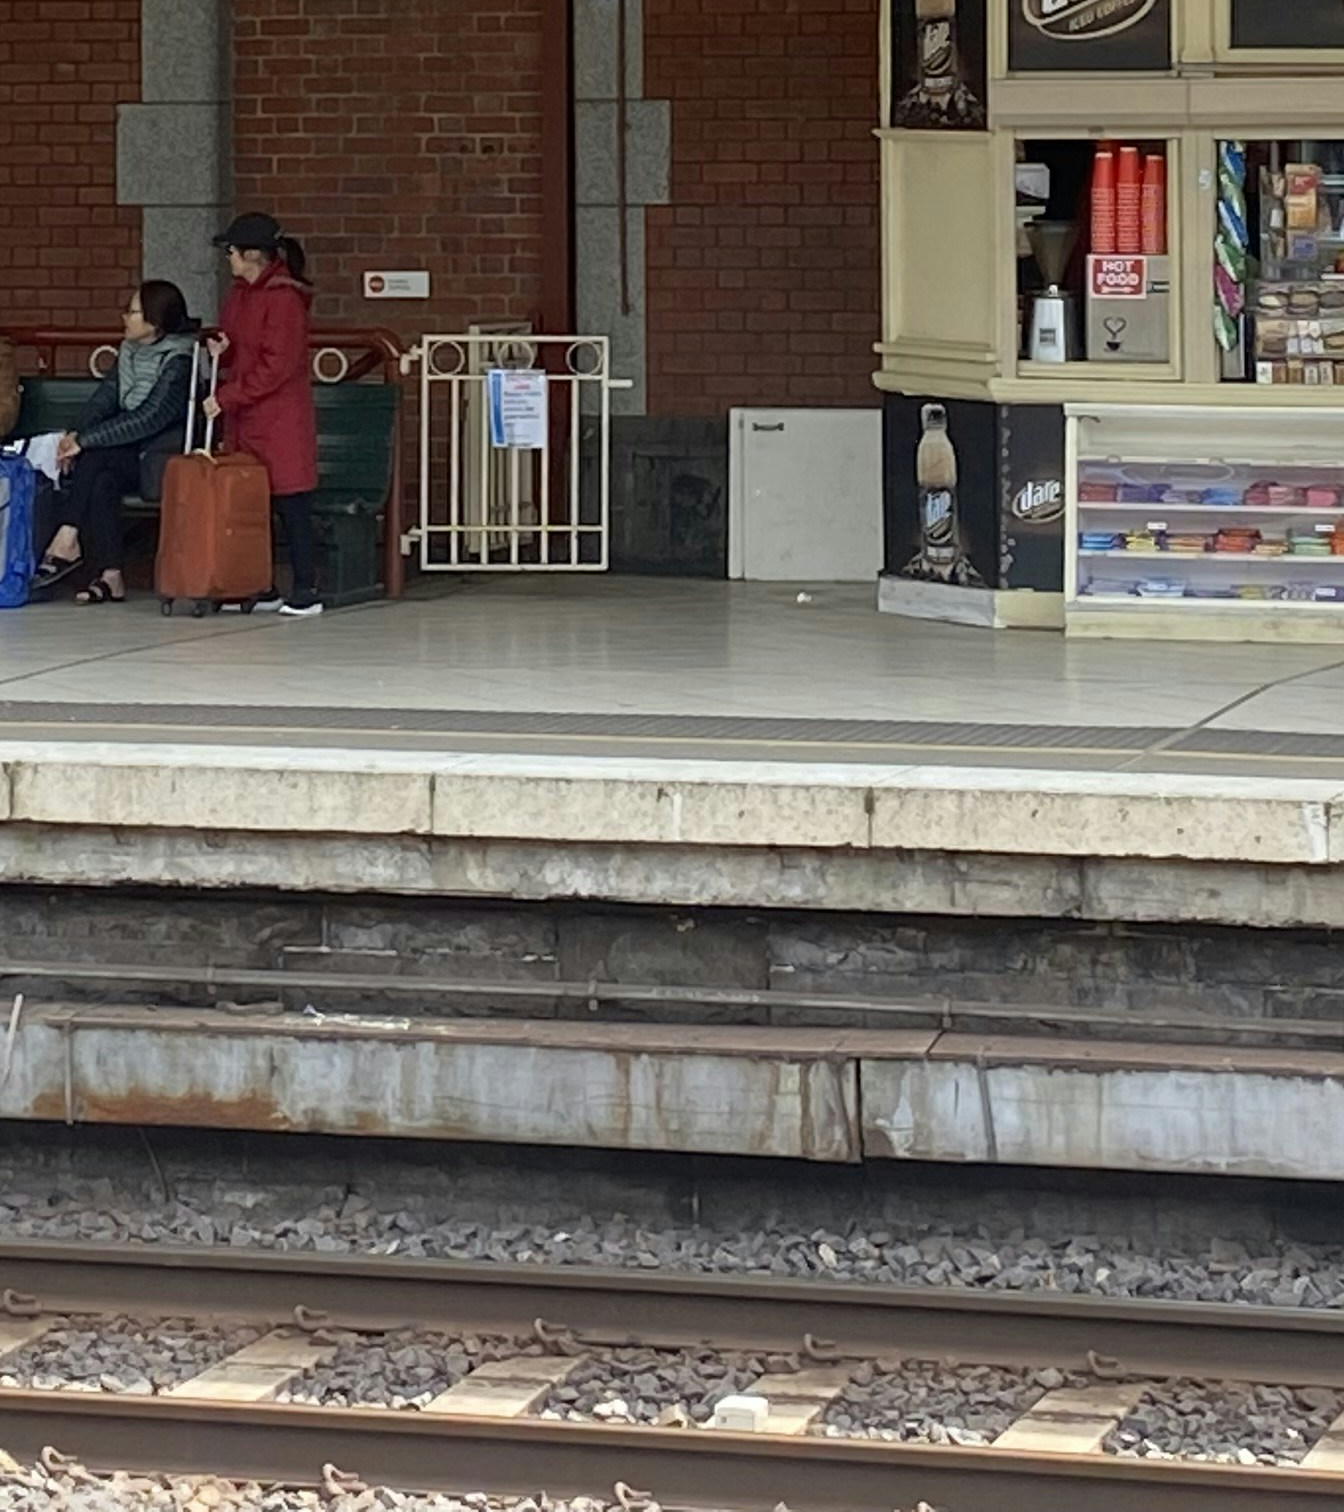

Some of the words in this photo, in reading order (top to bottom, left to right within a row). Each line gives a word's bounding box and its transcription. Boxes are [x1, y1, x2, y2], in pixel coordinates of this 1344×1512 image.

[1102, 261, 1134, 272] HOT
[1097, 273, 1139, 285] FOOD
[1020, 481, 1060, 511] dare
